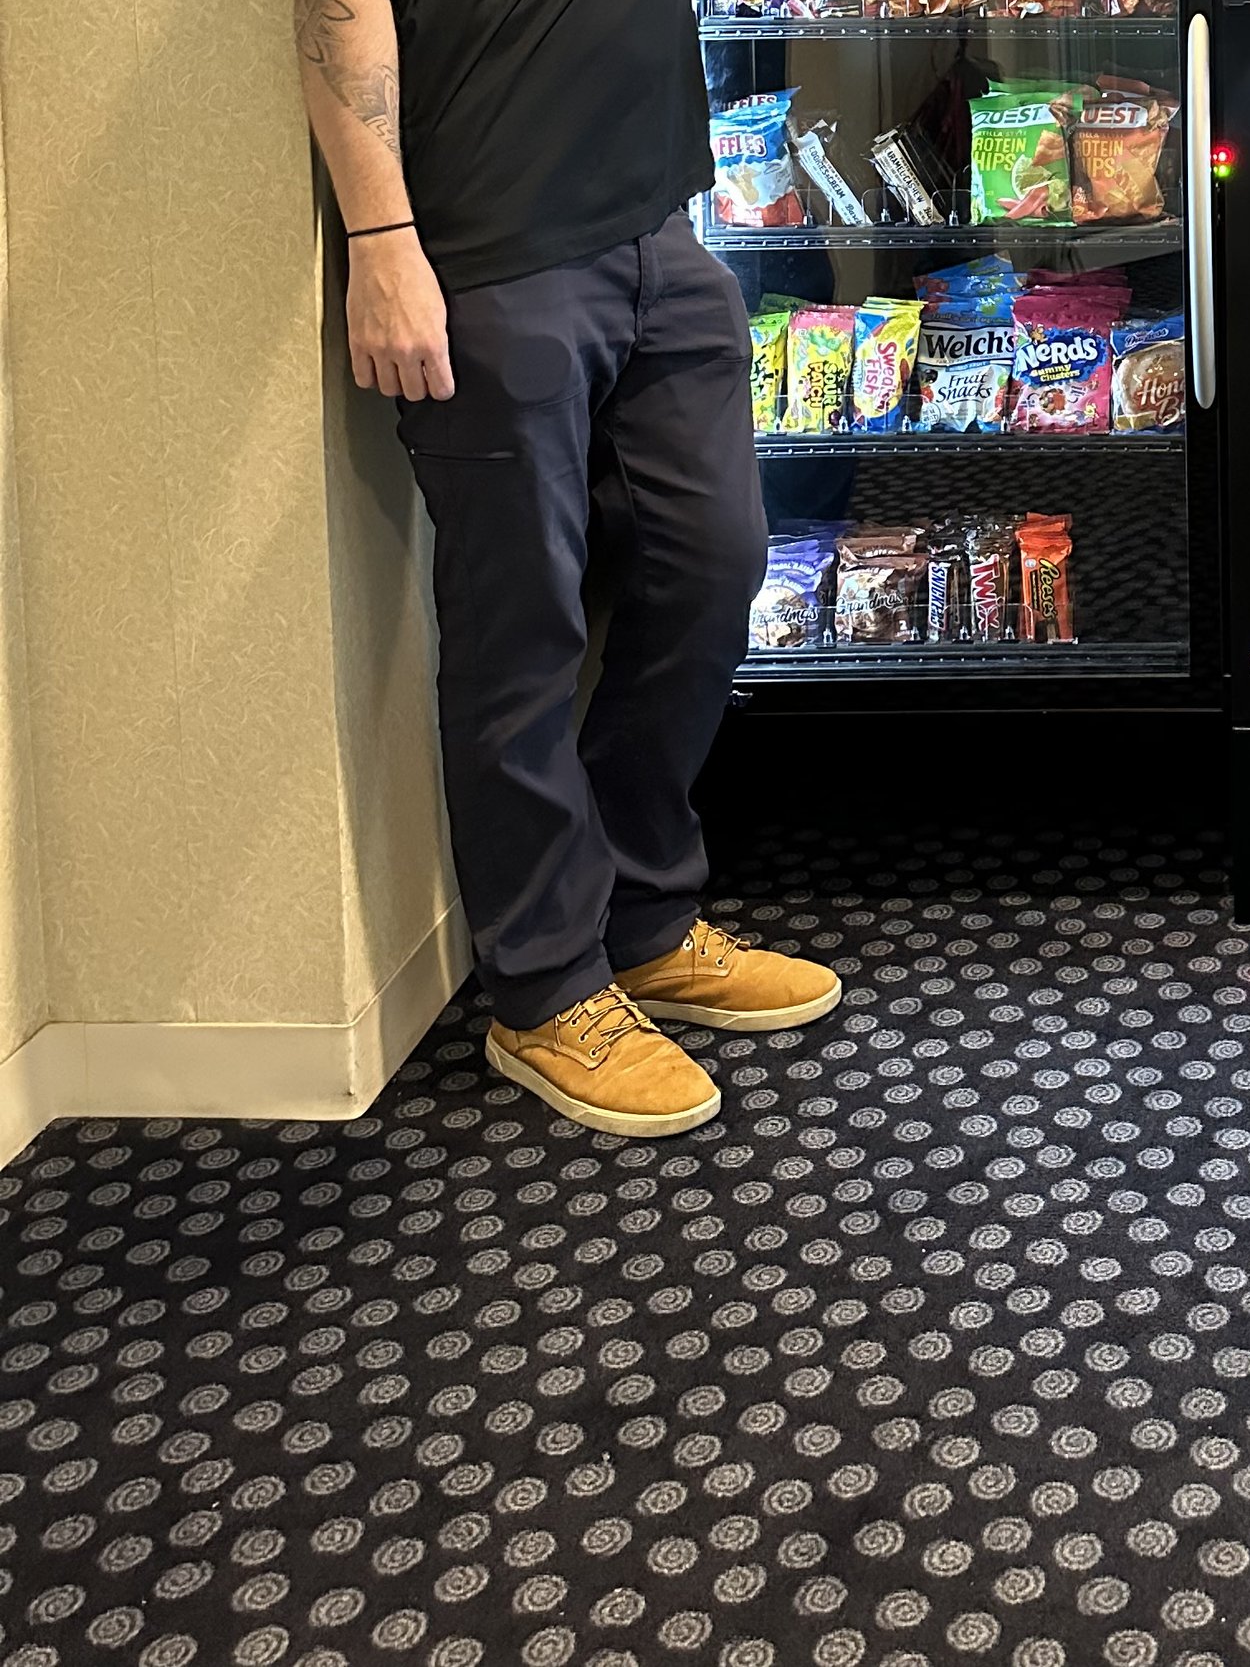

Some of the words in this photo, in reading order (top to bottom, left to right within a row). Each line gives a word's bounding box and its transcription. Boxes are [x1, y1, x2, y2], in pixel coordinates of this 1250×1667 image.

[723, 95, 777, 110] FFLES
[974, 107, 1042, 126] QUEST
[1084, 107, 1140, 124] UEST
[715, 134, 766, 155] FFLES
[975, 138, 1026, 153] ROTEIN
[1074, 140, 1124, 157] ROTEIN
[974, 153, 1017, 171] HIPS
[1085, 157, 1117, 178] IPS
[924, 331, 1014, 359] Welch's
[1015, 336, 1098, 371] Nerds
[863, 358, 882, 395] Fish
[949, 372, 987, 388] Fruit
[1030, 363, 1071, 377] Gummy
[1040, 371, 1080, 382] Clusters
[809, 362, 824, 408] PATCH
[824, 361, 842, 408] SOUR
[936, 385, 993, 403] Snacks
[1137, 378, 1185, 405] Hon
[930, 564, 945, 629] SNICKERS
[973, 559, 1000, 632] TWIX
[1039, 559, 1061, 619] Reese's
